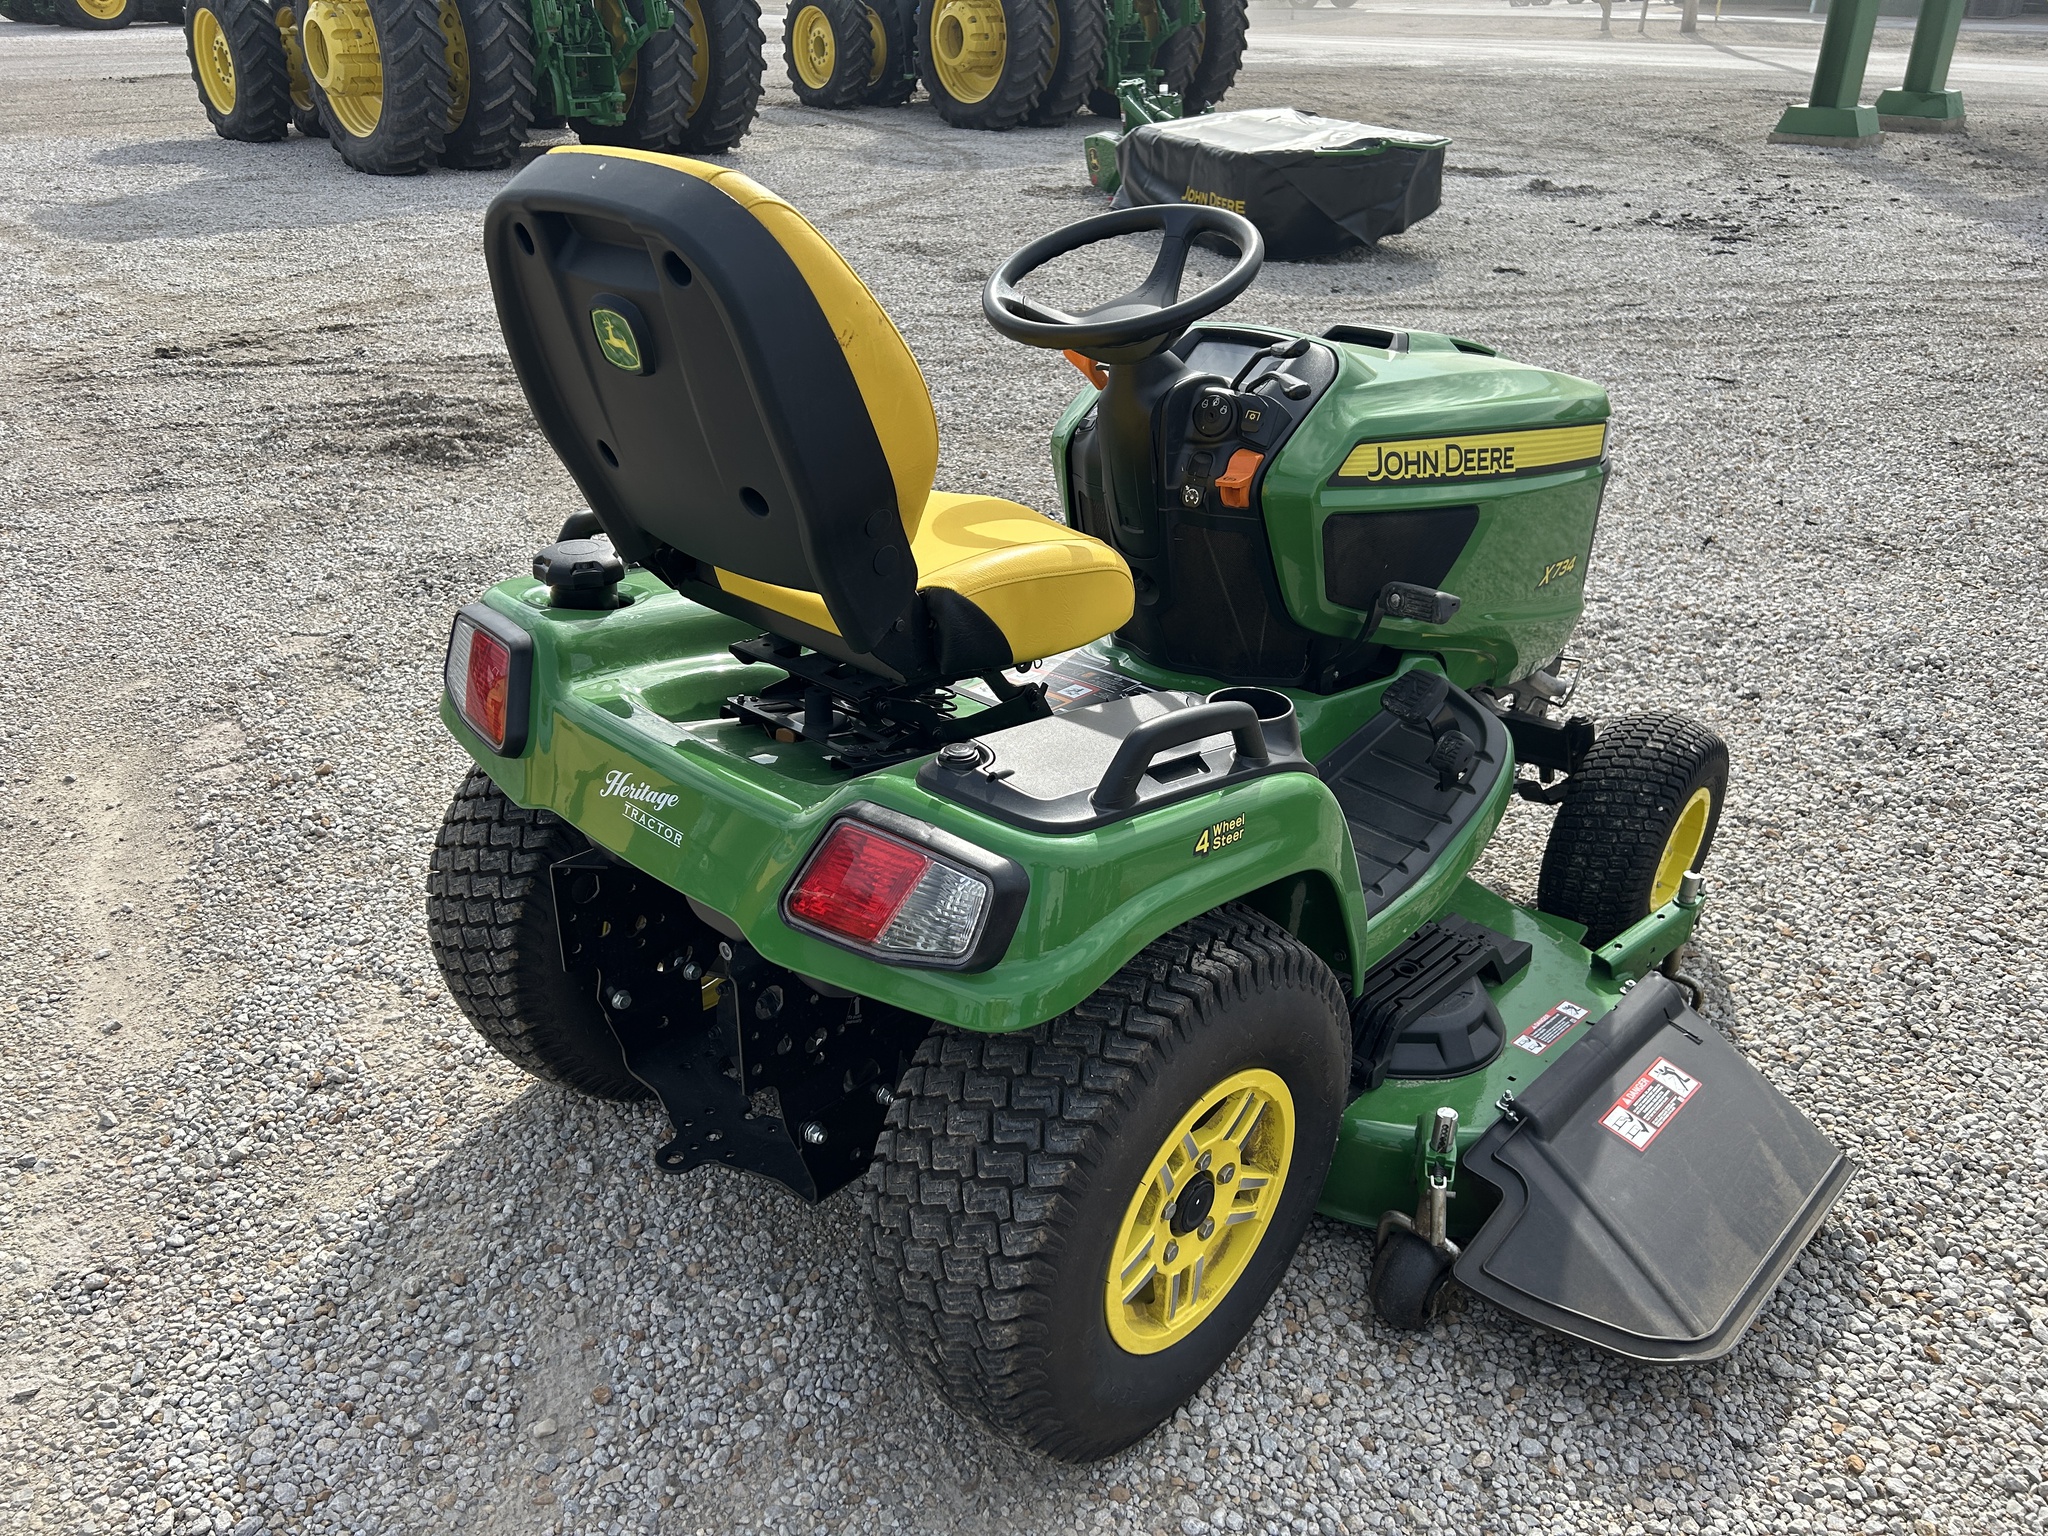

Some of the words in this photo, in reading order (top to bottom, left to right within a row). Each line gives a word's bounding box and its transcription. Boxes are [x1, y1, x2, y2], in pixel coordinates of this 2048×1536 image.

[1181, 185, 1208, 205] JOHN
[1209, 191, 1246, 215] DEERE
[1367, 446, 1439, 479] JOHN
[1445, 443, 1516, 474] DEERE
[1537, 555, 1577, 587] X734
[600, 769, 680, 811] Heritage
[623, 803, 683, 845] TRACTOR
[1194, 828, 1210, 854] 4
[1212, 812, 1245, 837] Wheel
[1212, 828, 1245, 850] Steer
[1625, 1077, 1651, 1102] DANGER
